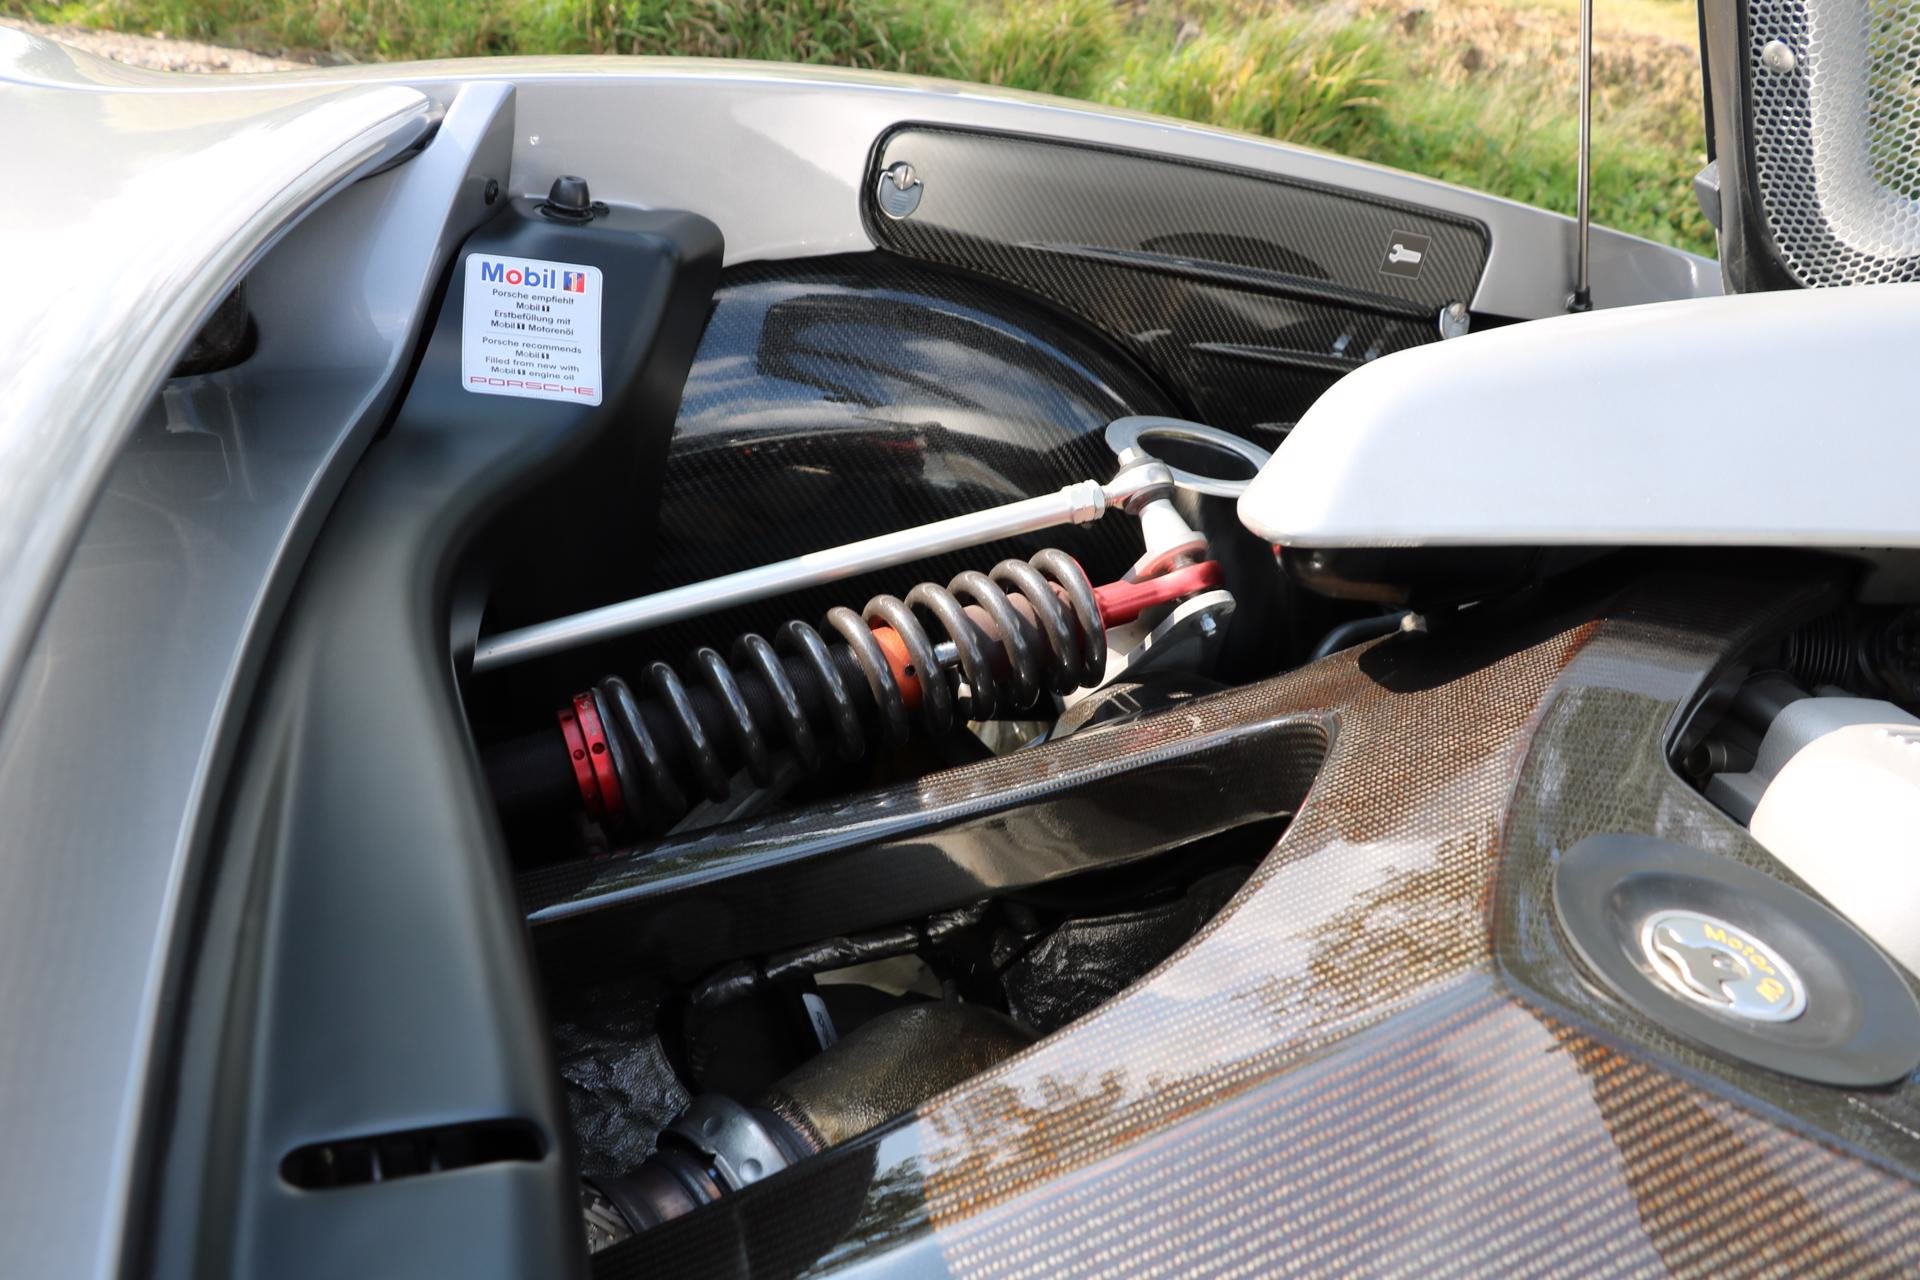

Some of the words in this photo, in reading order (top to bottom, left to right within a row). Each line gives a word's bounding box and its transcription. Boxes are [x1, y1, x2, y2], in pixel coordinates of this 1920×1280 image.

[481, 261, 556, 289] Mobil
[492, 288, 529, 300] Porsche
[531, 295, 574, 305] empfiehlt
[516, 302, 540, 312] Mobil
[494, 310, 554, 325] Erstbefüllung
[490, 320, 515, 329] Mobil
[528, 324, 574, 335] Motorenöl
[482, 336, 519, 347] Porsche
[522, 342, 582, 354] recommends
[515, 350, 540, 359] Mobil
[485, 356, 510, 365] Filled
[513, 359, 534, 368] from
[537, 362, 557, 370] new
[560, 364, 580, 373] with
[491, 366, 516, 375] Mobil
[529, 371, 560, 380] engine
[563, 373, 575, 381] oil
[470, 376, 594, 396] PORSCHE
[1703, 923, 1776, 976] Motor
